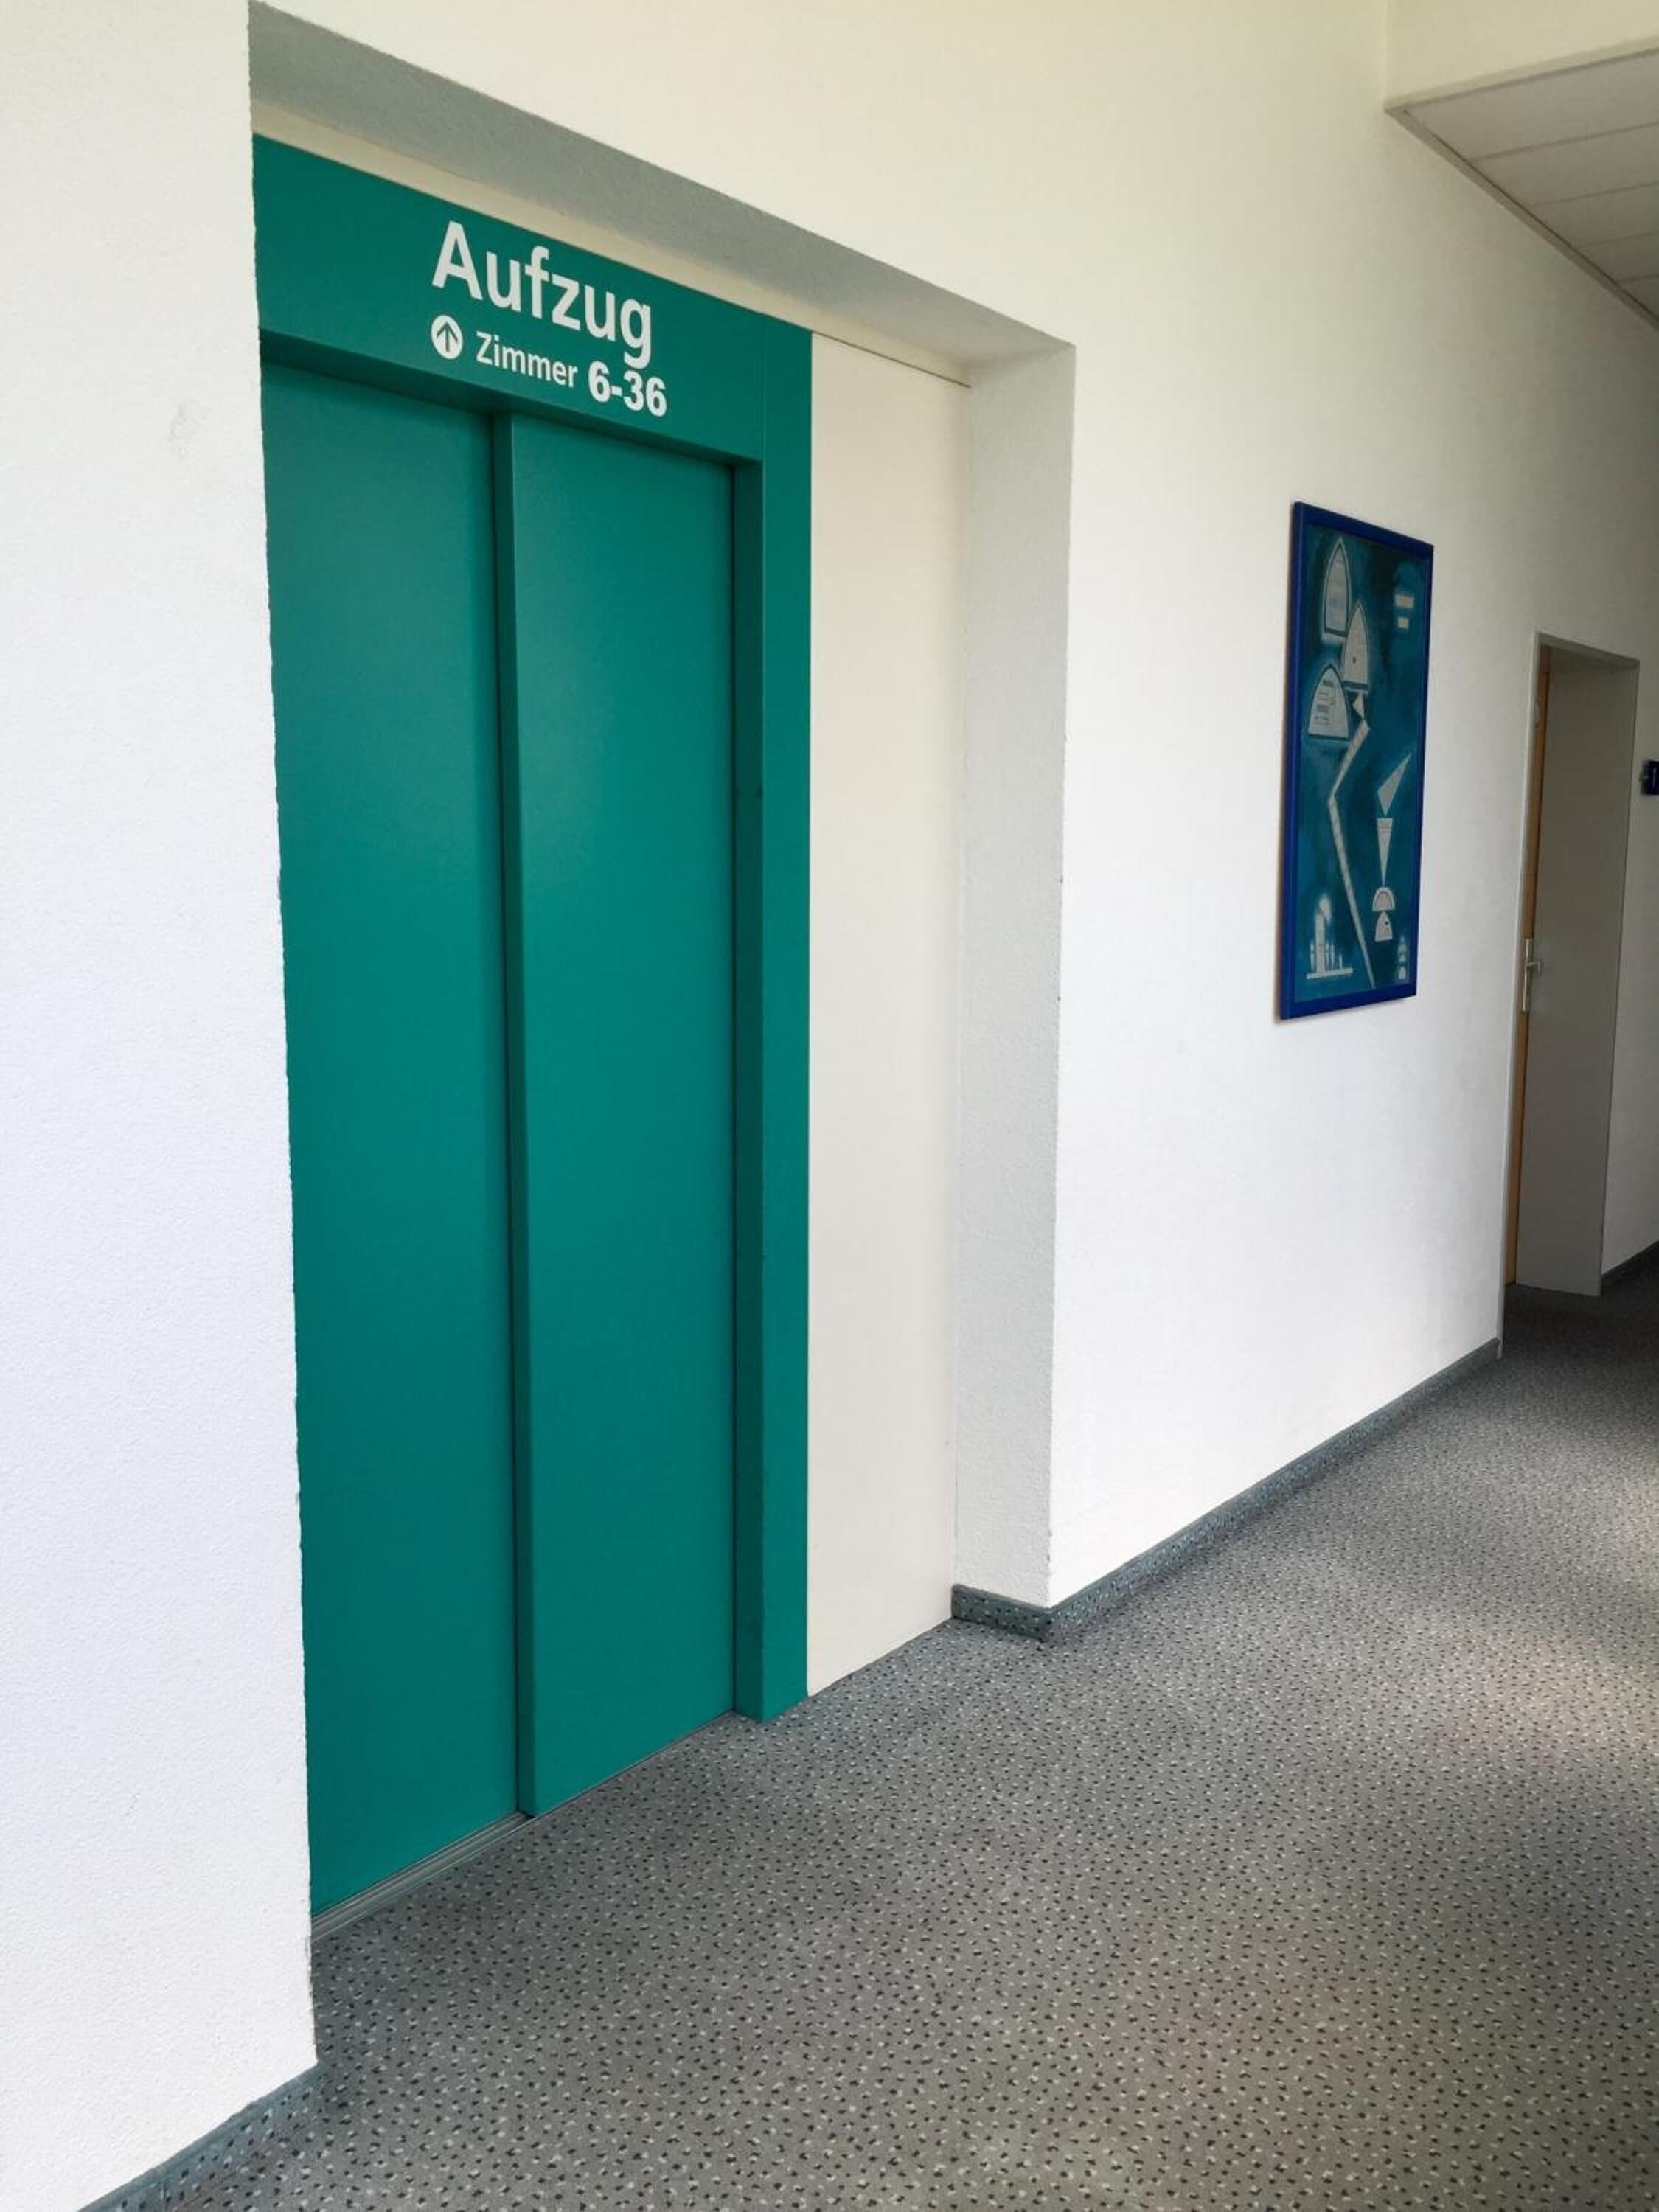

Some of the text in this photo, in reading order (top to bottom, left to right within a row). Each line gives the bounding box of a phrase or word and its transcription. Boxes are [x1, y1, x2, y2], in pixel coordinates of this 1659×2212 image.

[431, 220, 651, 369] Aufzug
[476, 330, 667, 417] Zimmer 6-36
